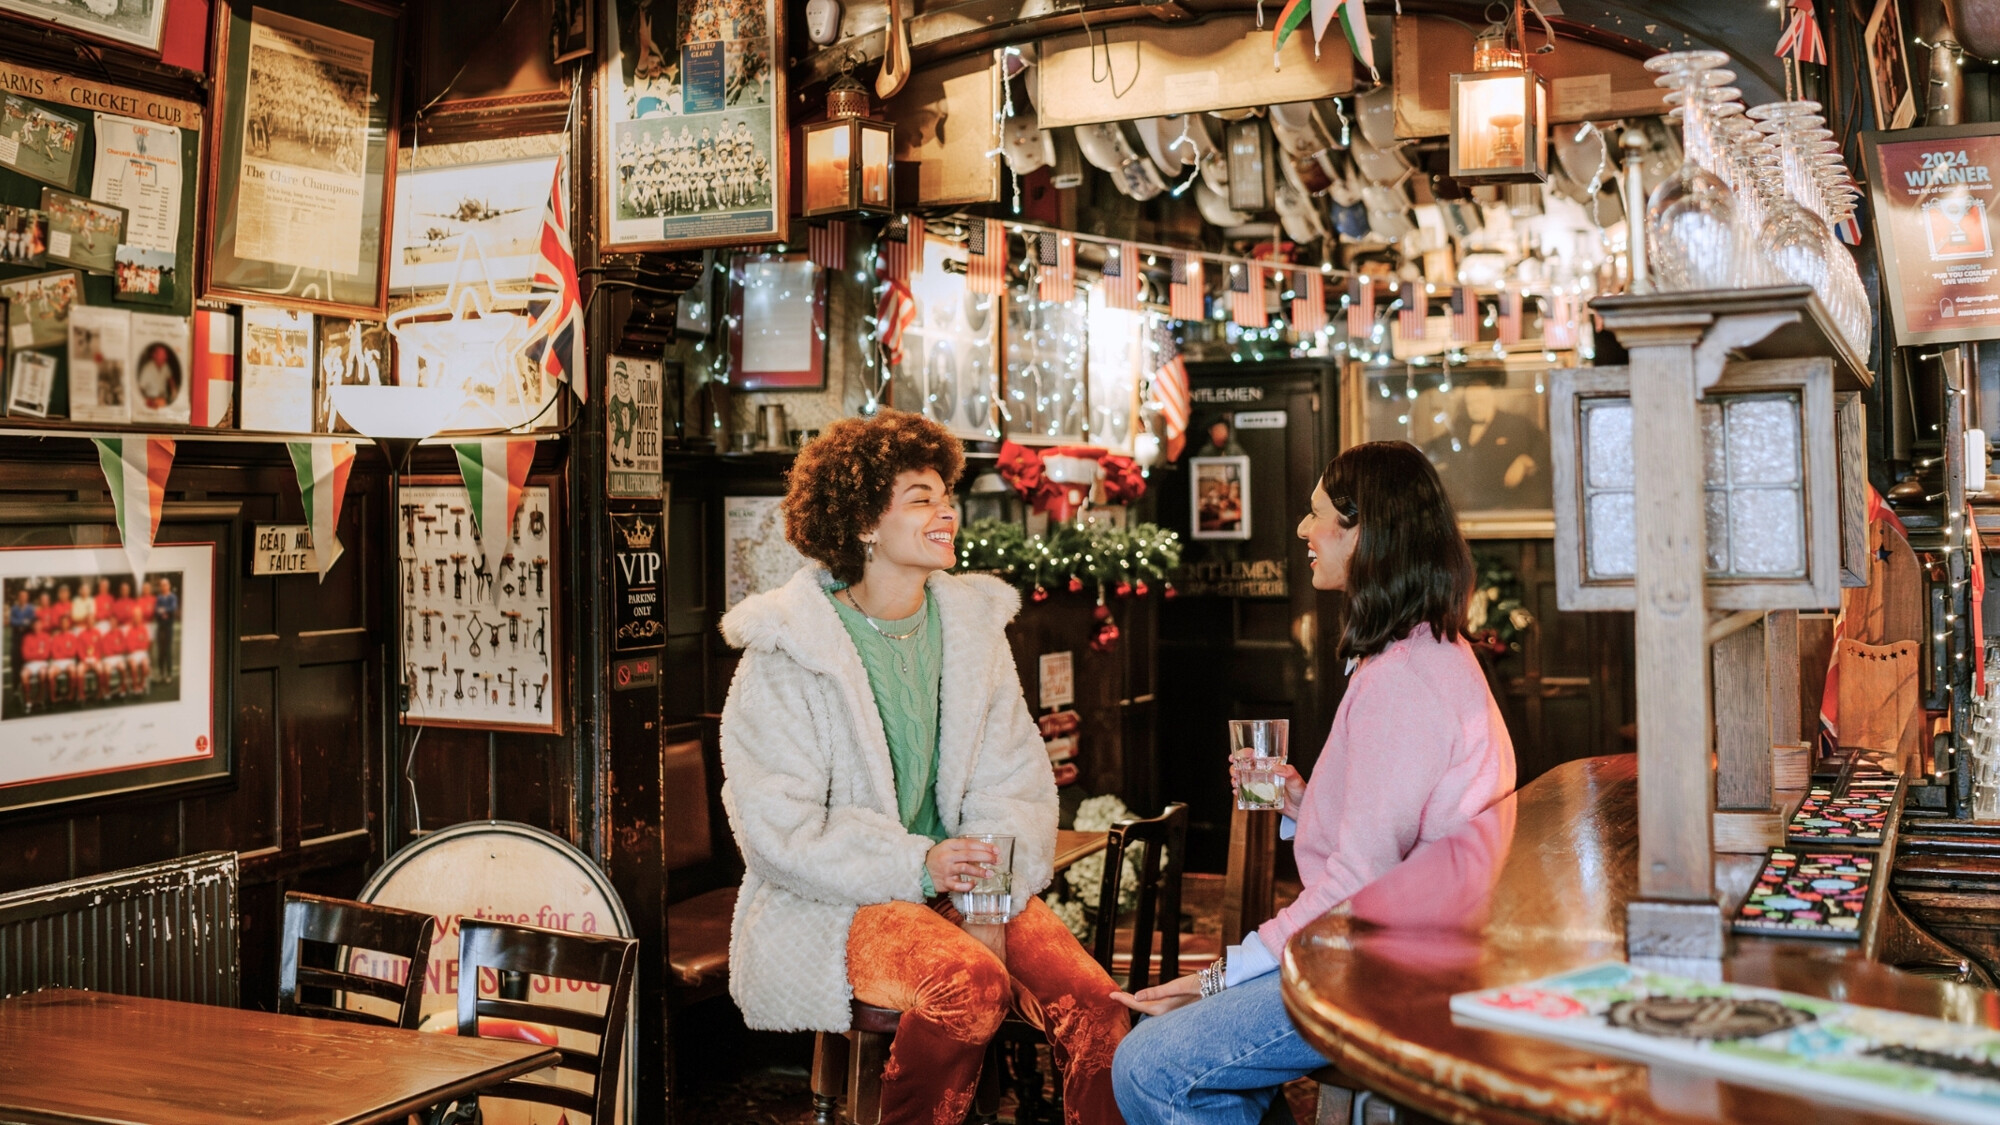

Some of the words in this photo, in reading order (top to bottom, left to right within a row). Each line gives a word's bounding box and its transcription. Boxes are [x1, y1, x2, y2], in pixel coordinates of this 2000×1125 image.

[691, 50, 713, 58] GLORY
[0, 73, 44, 95] ARMS
[71, 87, 139, 114] CRICKET
[147, 102, 182, 123] CLUB
[1921, 150, 1969, 169] 2024
[244, 164, 265, 179] The
[270, 168, 299, 185] Clare
[302, 175, 360, 197] Champions
[1904, 166, 1991, 187] WINNER
[1946, 264, 1982, 272] LONDON'S
[1948, 270, 1964, 279] YOU
[1942, 278, 1957, 286] LIVE
[637, 379, 659, 404] DRINK
[637, 405, 659, 431] MORE
[637, 431, 659, 457] BEER.
[611, 473, 626, 492] LOCAL
[295, 527, 315, 550] MÍL
[617, 552, 661, 585] VIP
[628, 592, 656, 604] PARKING
[633, 605, 652, 617] ONLY
[637, 661, 649, 674] NO
[536, 904, 575, 931] for
[582, 911, 597, 934] a
